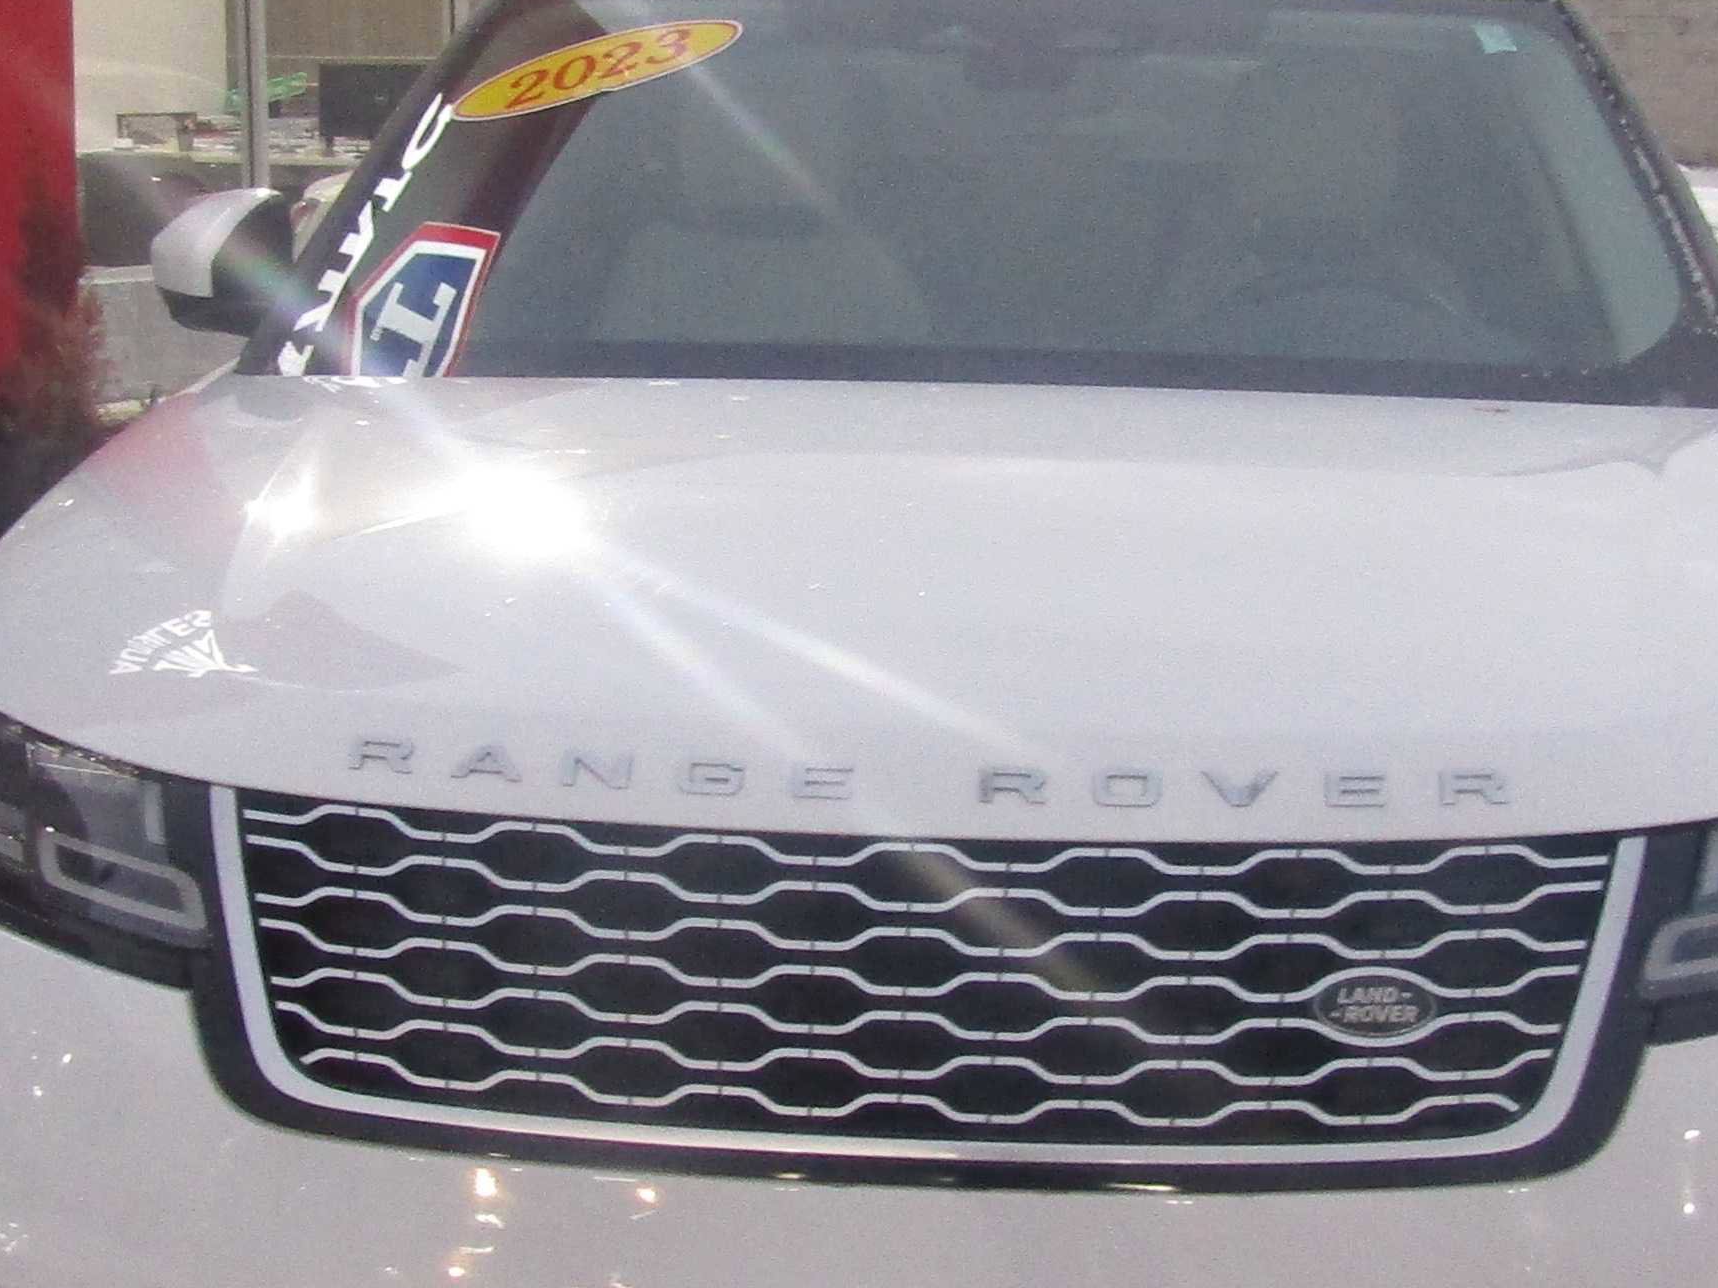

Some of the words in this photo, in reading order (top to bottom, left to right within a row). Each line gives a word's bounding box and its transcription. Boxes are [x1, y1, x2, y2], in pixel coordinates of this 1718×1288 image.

[506, 27, 691, 108] 2023
[347, 739, 854, 801] RANGE
[978, 768, 1509, 808] ROVER
